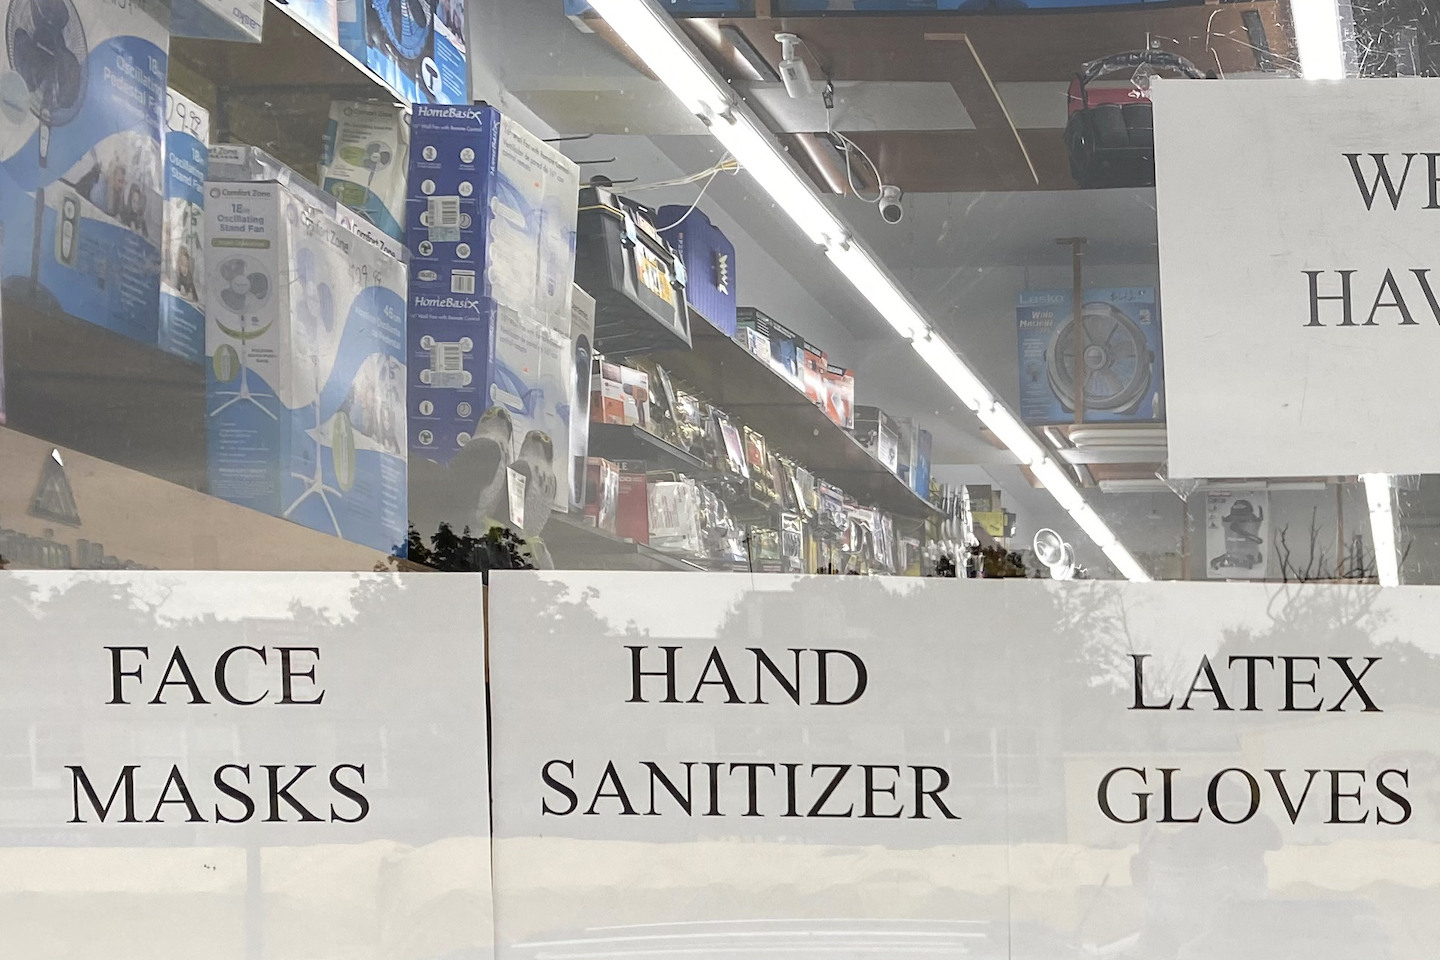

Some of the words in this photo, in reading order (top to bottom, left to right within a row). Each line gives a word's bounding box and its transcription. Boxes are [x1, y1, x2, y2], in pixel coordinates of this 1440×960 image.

[418, 106, 482, 124] HomeBasix
[217, 215, 264, 225] Oscillating
[220, 224, 246, 233] Stand
[248, 225, 265, 233] Fan
[415, 296, 480, 314] HomeBasix
[1020, 294, 1064, 304] Lasko
[103, 646, 326, 706] FACE
[624, 646, 869, 706] HAND
[1126, 654, 1383, 713] LATEX
[64, 765, 370, 825] MASKS
[541, 760, 962, 821] SANITIZER
[1097, 768, 1413, 826] GLOVES
